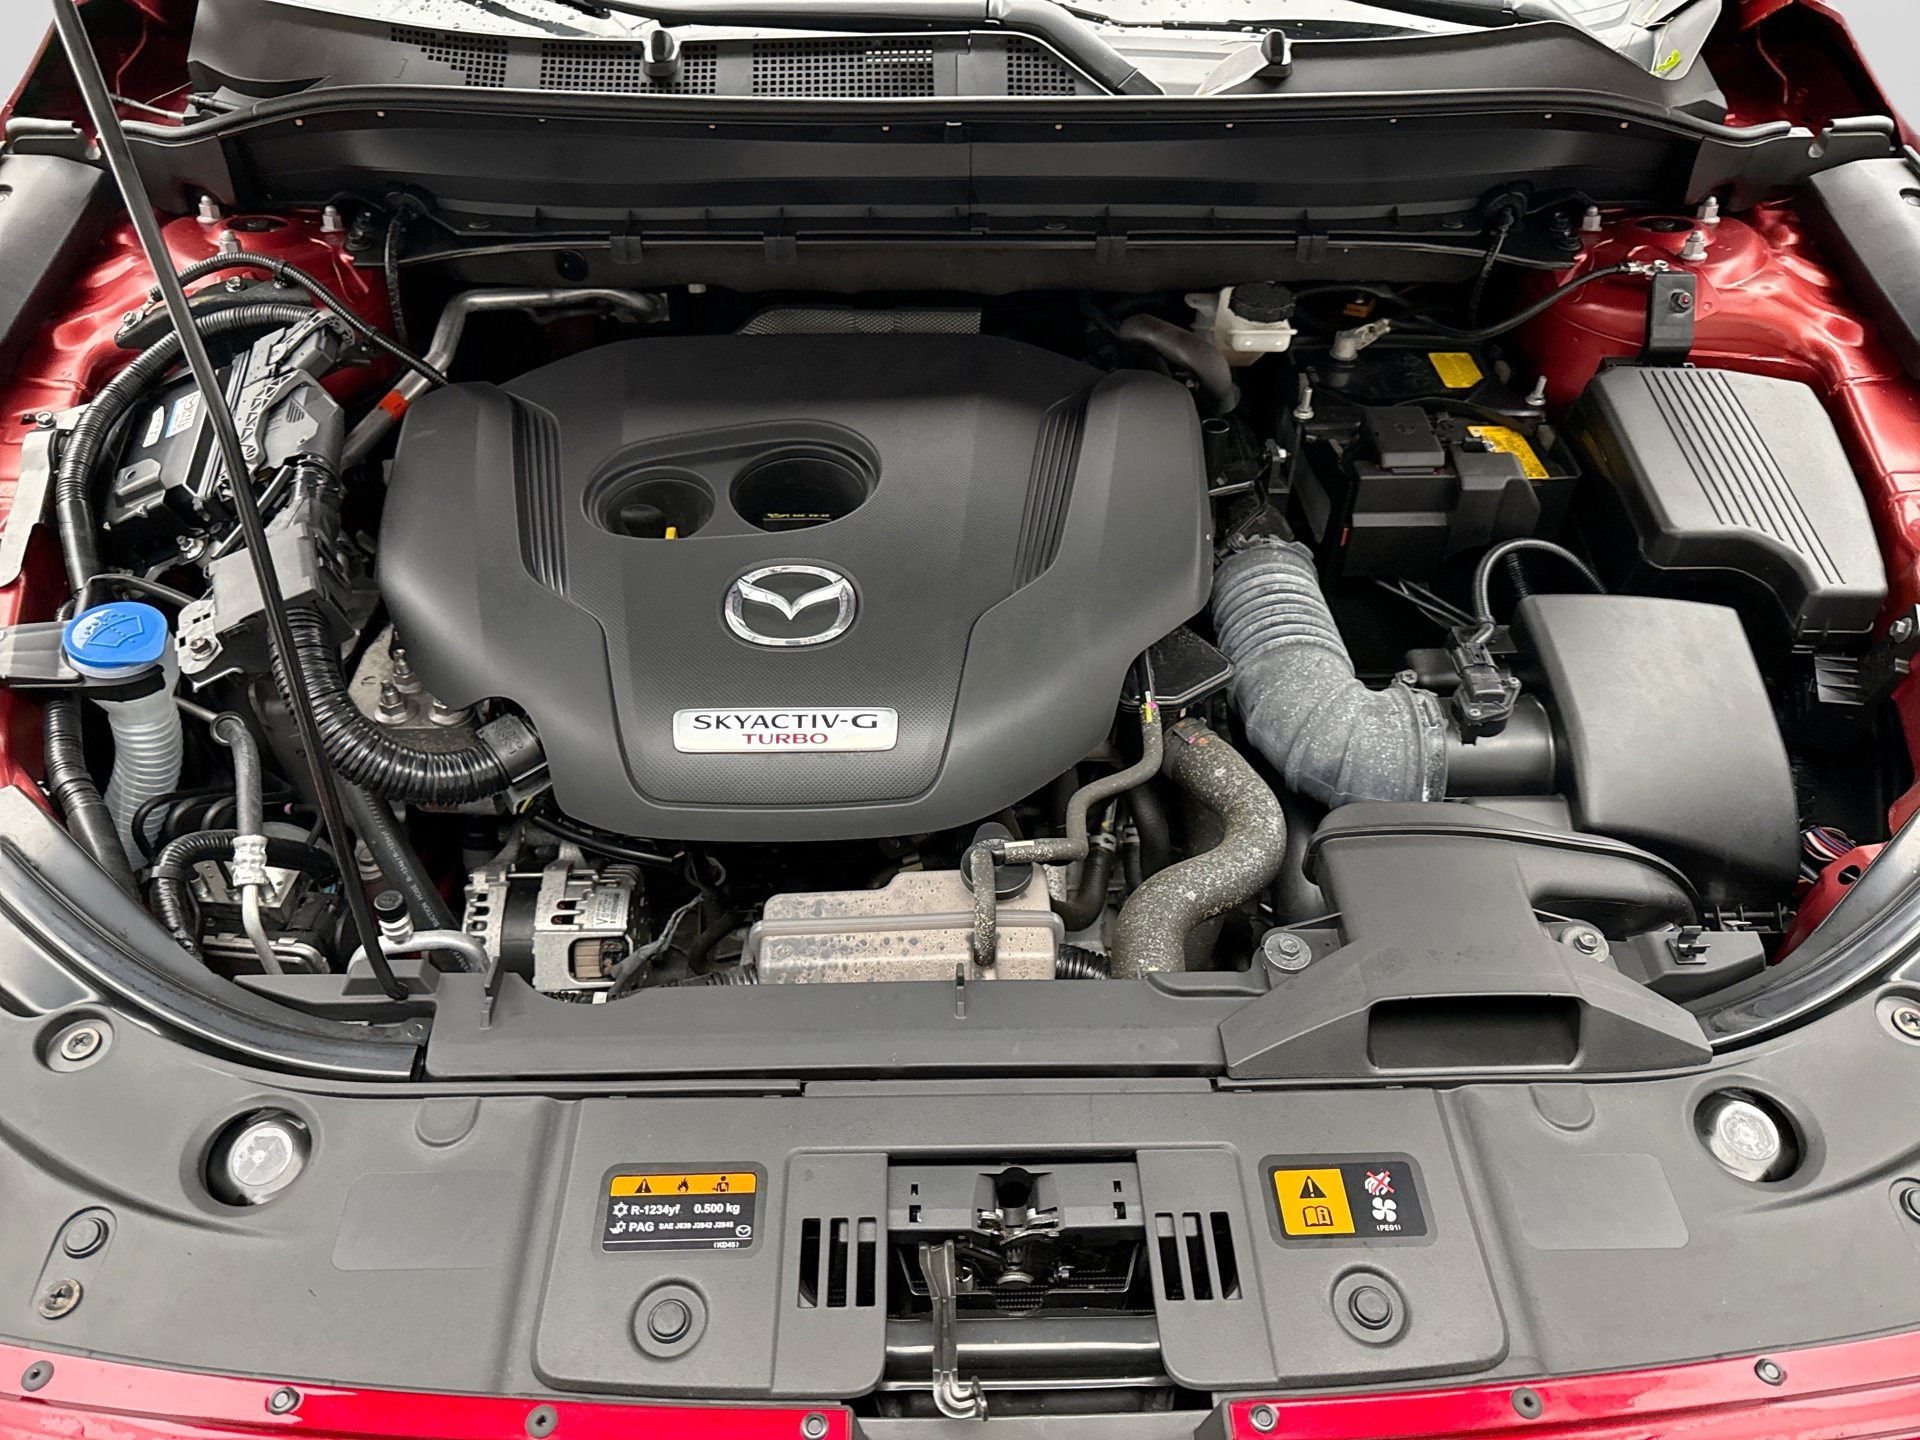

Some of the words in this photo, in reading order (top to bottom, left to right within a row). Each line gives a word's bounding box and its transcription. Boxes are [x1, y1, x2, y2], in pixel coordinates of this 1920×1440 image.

[693, 714, 878, 729] SKYACTIV-G
[742, 733, 828, 744] TURBO
[631, 1204, 680, 1216] R-1234yf
[694, 1204, 724, 1214] 0.500
[726, 1203, 740, 1215] kg
[629, 1222, 654, 1232] PAG
[659, 1222, 674, 1230] SAE
